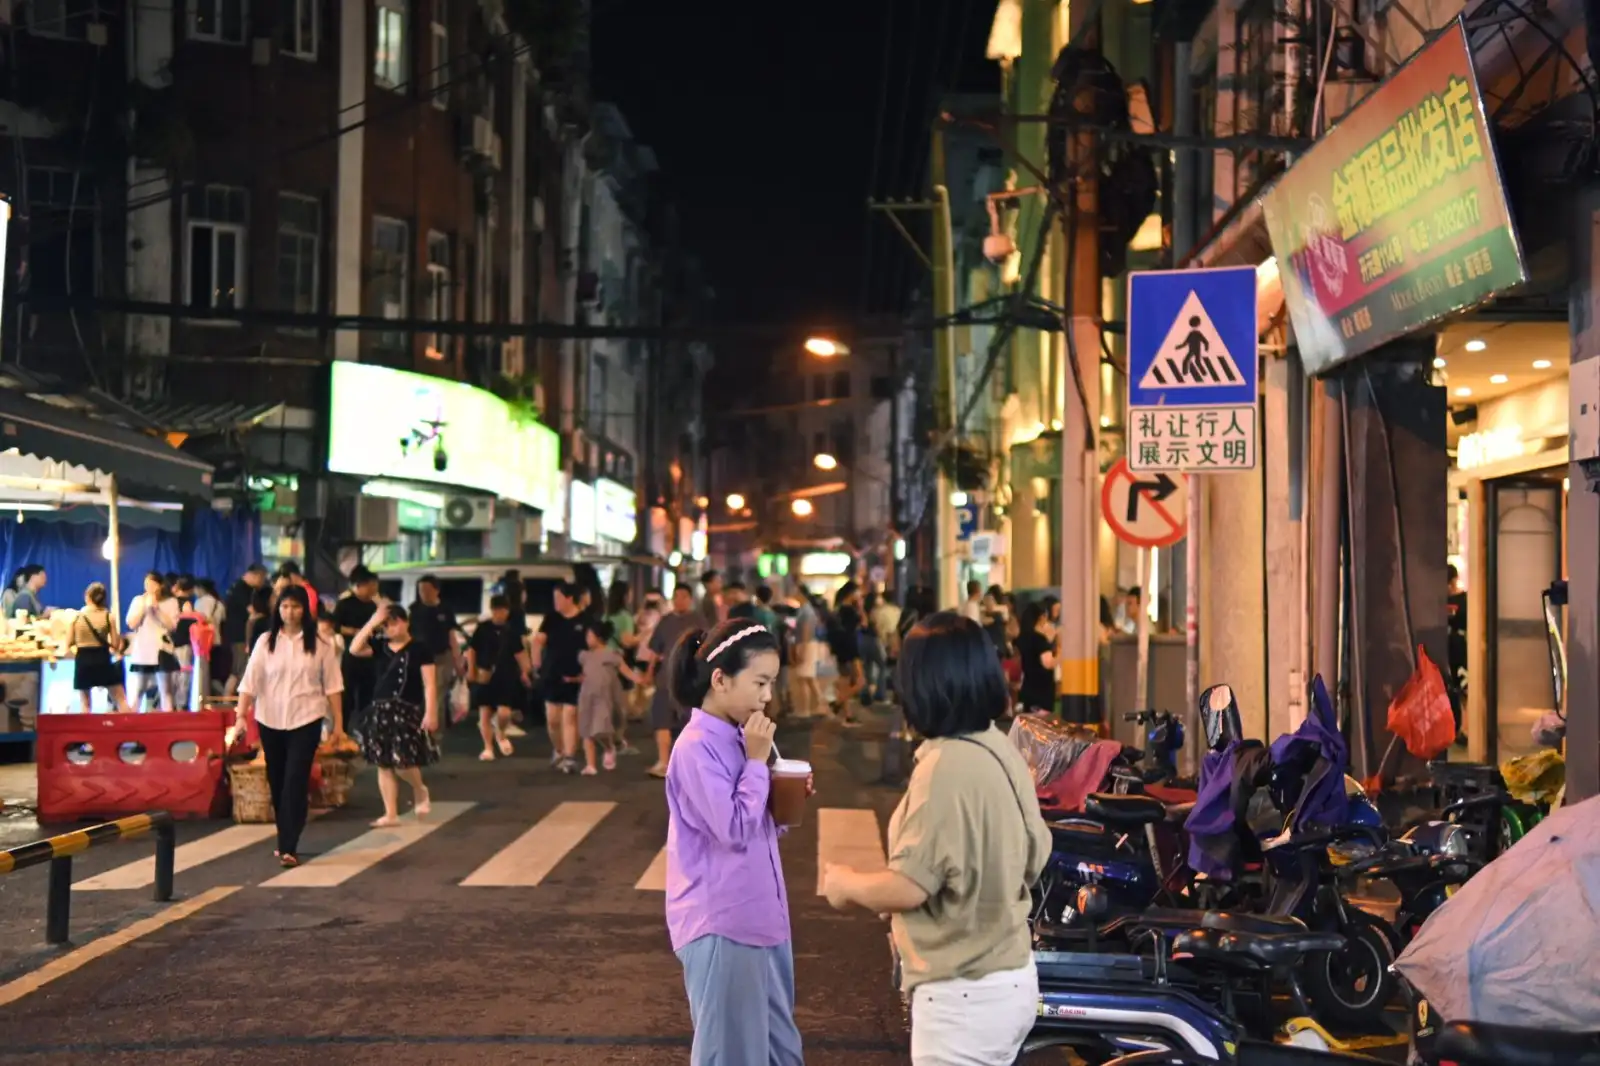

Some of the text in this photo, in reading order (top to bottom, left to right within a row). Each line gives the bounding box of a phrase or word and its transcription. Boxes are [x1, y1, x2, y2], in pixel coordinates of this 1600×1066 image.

[1138, 410, 1245, 438] 礼让行人
[1138, 440, 1246, 465] 展示文明
